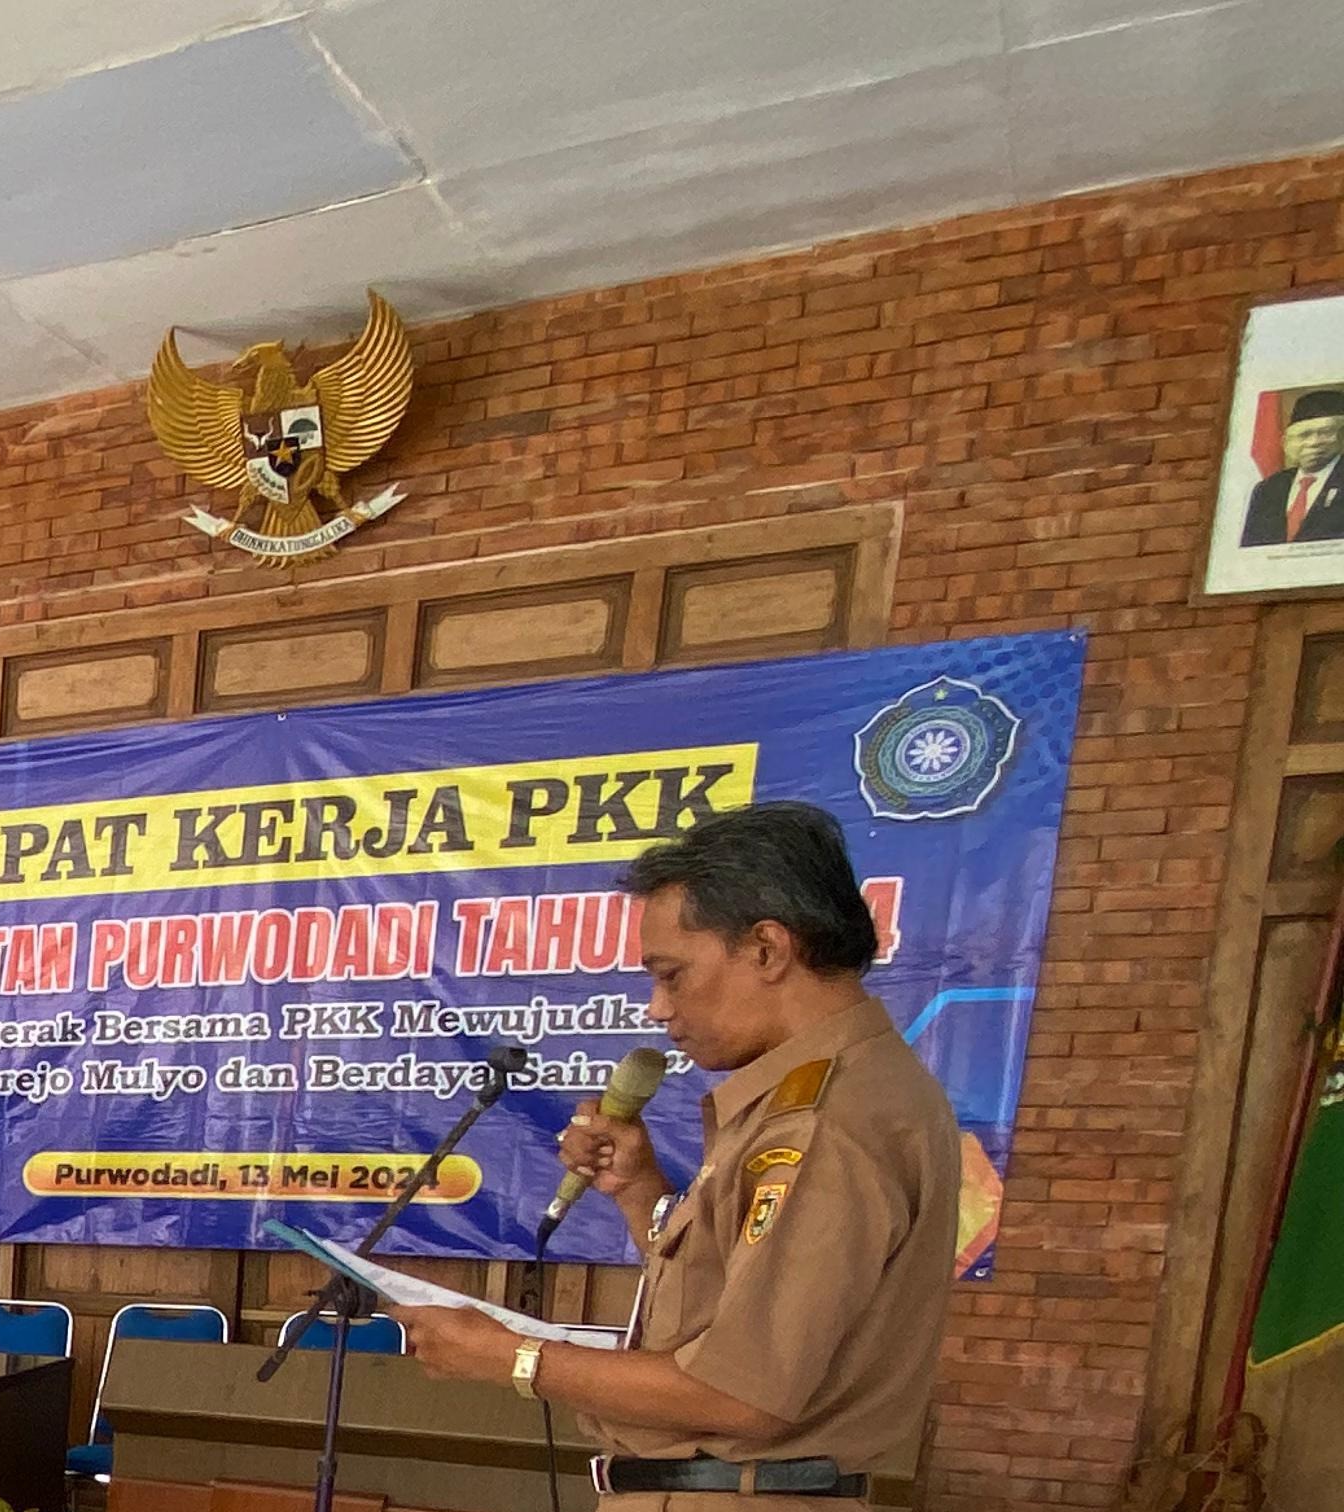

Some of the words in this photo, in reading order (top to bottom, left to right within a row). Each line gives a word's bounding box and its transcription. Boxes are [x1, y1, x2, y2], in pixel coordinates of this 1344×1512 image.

[169, 784, 474, 872] KERJA
[499, 763, 735, 850] PKK
[89, 902, 439, 990] PURWODADI
[93, 1011, 270, 1044] Bersama
[282, 1004, 384, 1039] PKK
[393, 995, 667, 1043] Mewujudka
[81, 1059, 208, 1099] Mulyo
[217, 1056, 297, 1090] dan
[310, 1054, 492, 1098] Berdaya
[509, 1051, 611, 1091] Sain
[54, 1162, 227, 1191] Purwodadi,
[238, 1163, 270, 1188] 13
[281, 1163, 339, 1189] Mei
